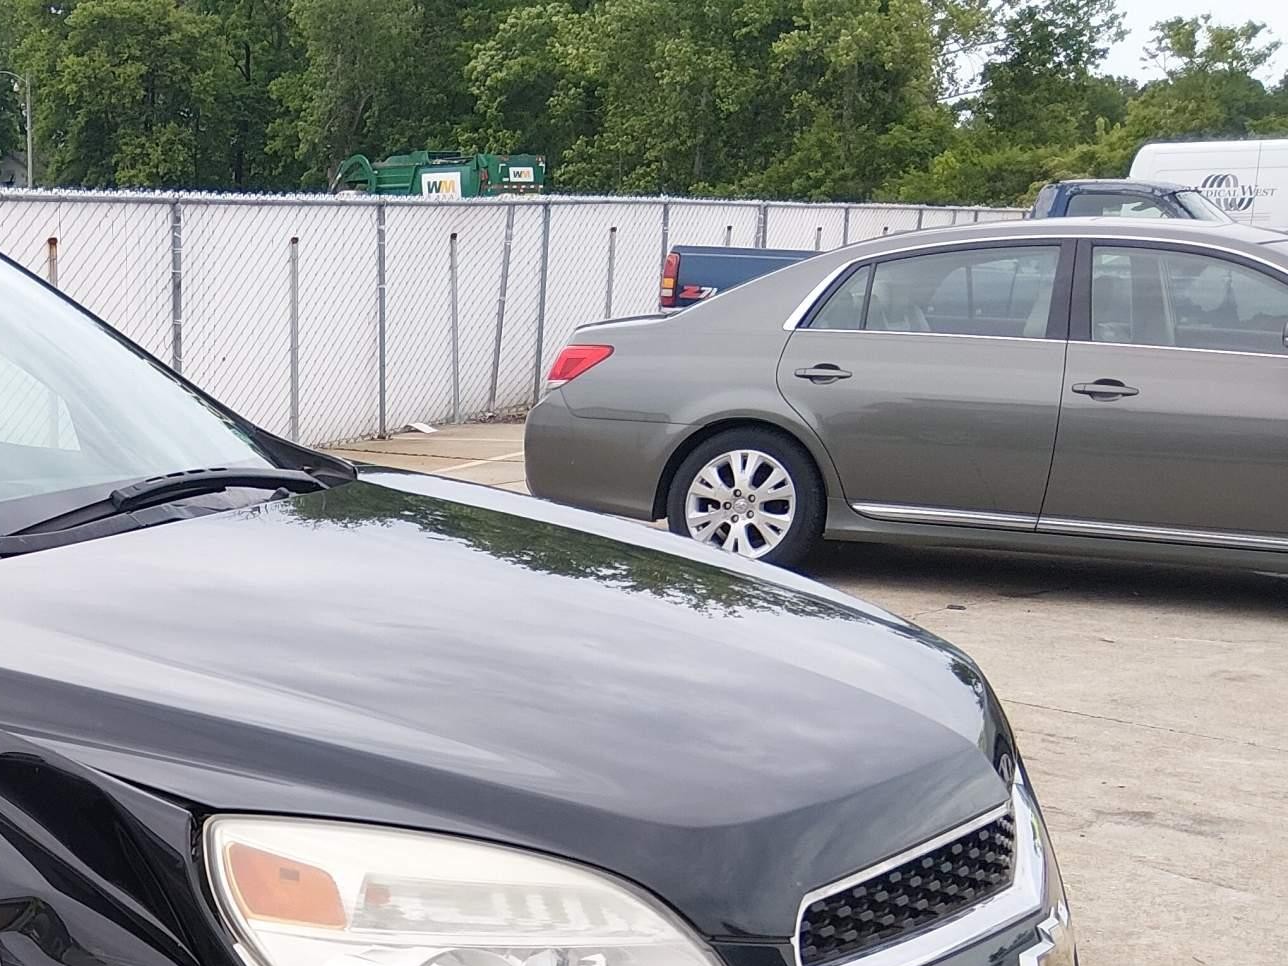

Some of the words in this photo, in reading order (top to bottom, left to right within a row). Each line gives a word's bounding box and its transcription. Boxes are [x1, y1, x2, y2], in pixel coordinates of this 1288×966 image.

[513, 170, 530, 178] WM
[427, 180, 456, 194] WM
[1205, 188, 1240, 198] DICAL
[679, 284, 718, 299] Z71
